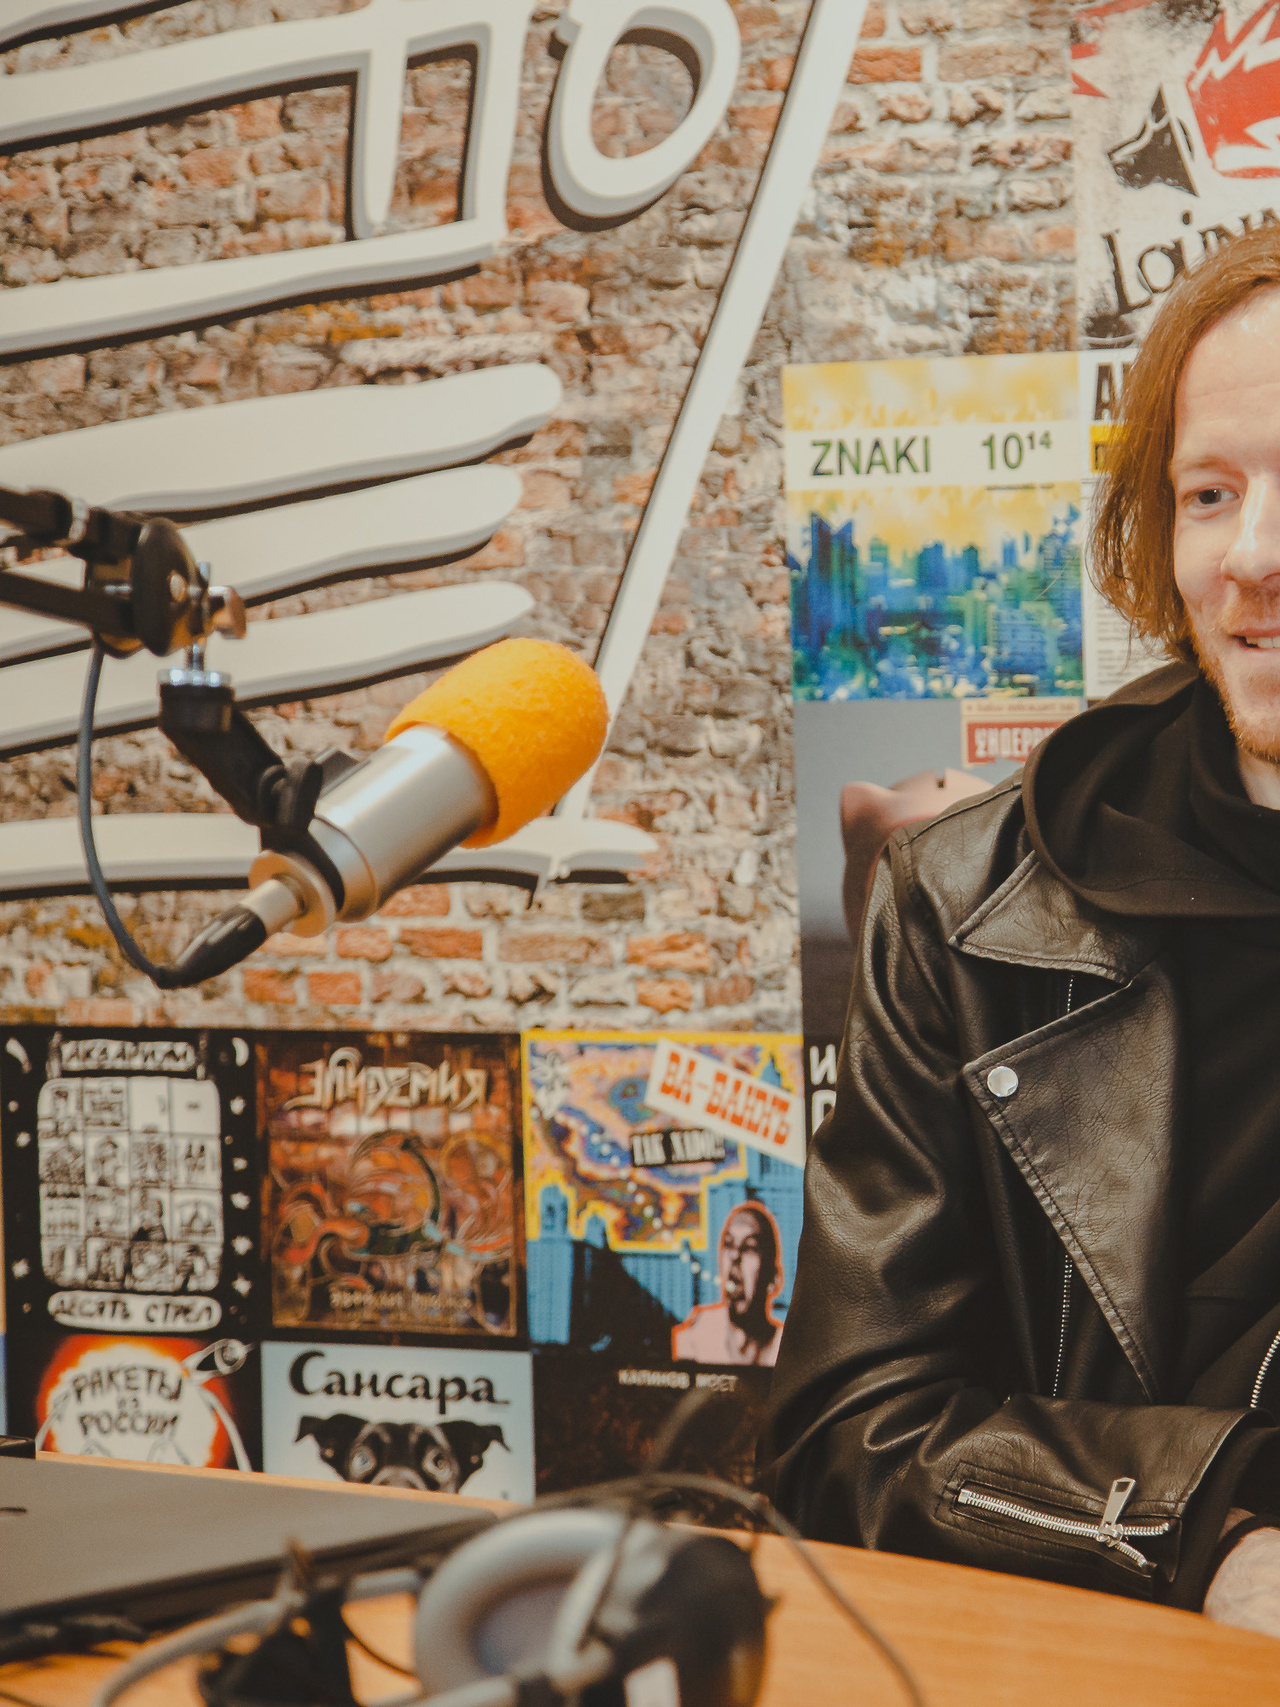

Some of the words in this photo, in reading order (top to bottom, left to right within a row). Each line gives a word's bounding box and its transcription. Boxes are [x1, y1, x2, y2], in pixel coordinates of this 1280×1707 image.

[811, 435, 931, 477] ZNAKI
[72, 1366, 183, 1404] РАКЕТЫ
[288, 1349, 512, 1415] Сансара
